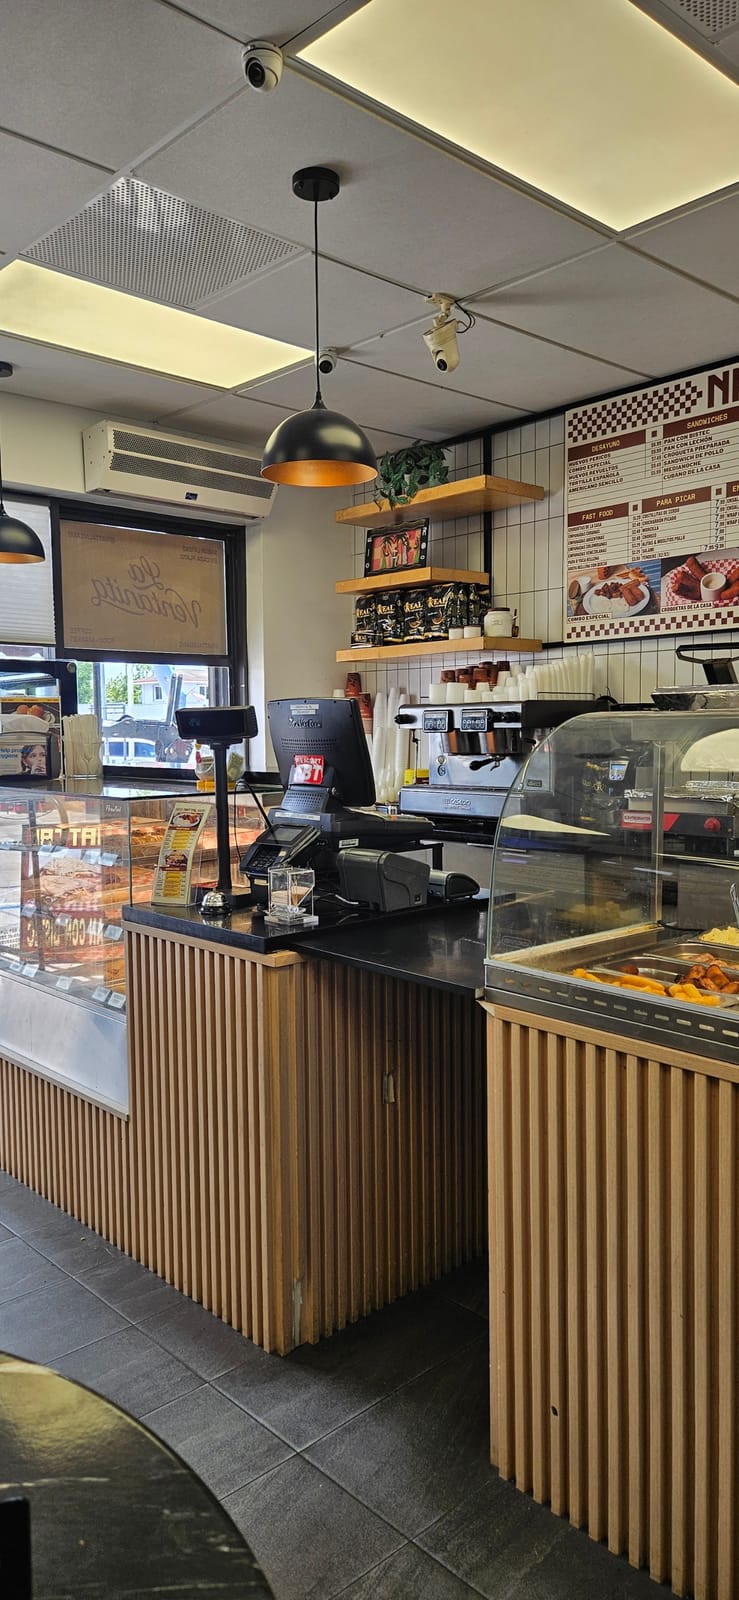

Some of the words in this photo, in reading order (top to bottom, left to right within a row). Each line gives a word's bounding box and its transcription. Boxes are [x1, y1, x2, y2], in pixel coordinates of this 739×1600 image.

[687, 413, 728, 429] SANDWICHES
[677, 434, 688, 442] CON
[689, 430, 710, 439] BISTEC
[592, 440, 620, 453] DESAYUNO
[664, 448, 694, 459] CROQUETA
[695, 440, 730, 452] PREPARADA
[676, 441, 688, 449] CON
[569, 459, 589, 467] HUEVOS
[590, 454, 611, 463] PERICOS
[664, 454, 694, 465] SANDWICH
[705, 448, 724, 457] POLLO
[569, 465, 587, 474] COMBO
[588, 460, 611, 470] ESPECIAL
[569, 472, 588, 480] HUEVOS
[590, 465, 618, 476] REVUELTOS
[664, 461, 701, 473] MEDIANOCHE
[664, 470, 687, 480] CUBANO
[705, 463, 720, 471] CASA
[569, 483, 597, 493] AMERICANO
[599, 478, 624, 488] SENCILLO
[570, 478, 593, 486] TORTILLA
[657, 498, 673, 507] PARA
[675, 493, 696, 503] PICAR
[582, 512, 596, 521] FAST
[599, 510, 614, 518] FOOD
[377, 604, 395, 615] REAL
[404, 601, 423, 613] REAL
